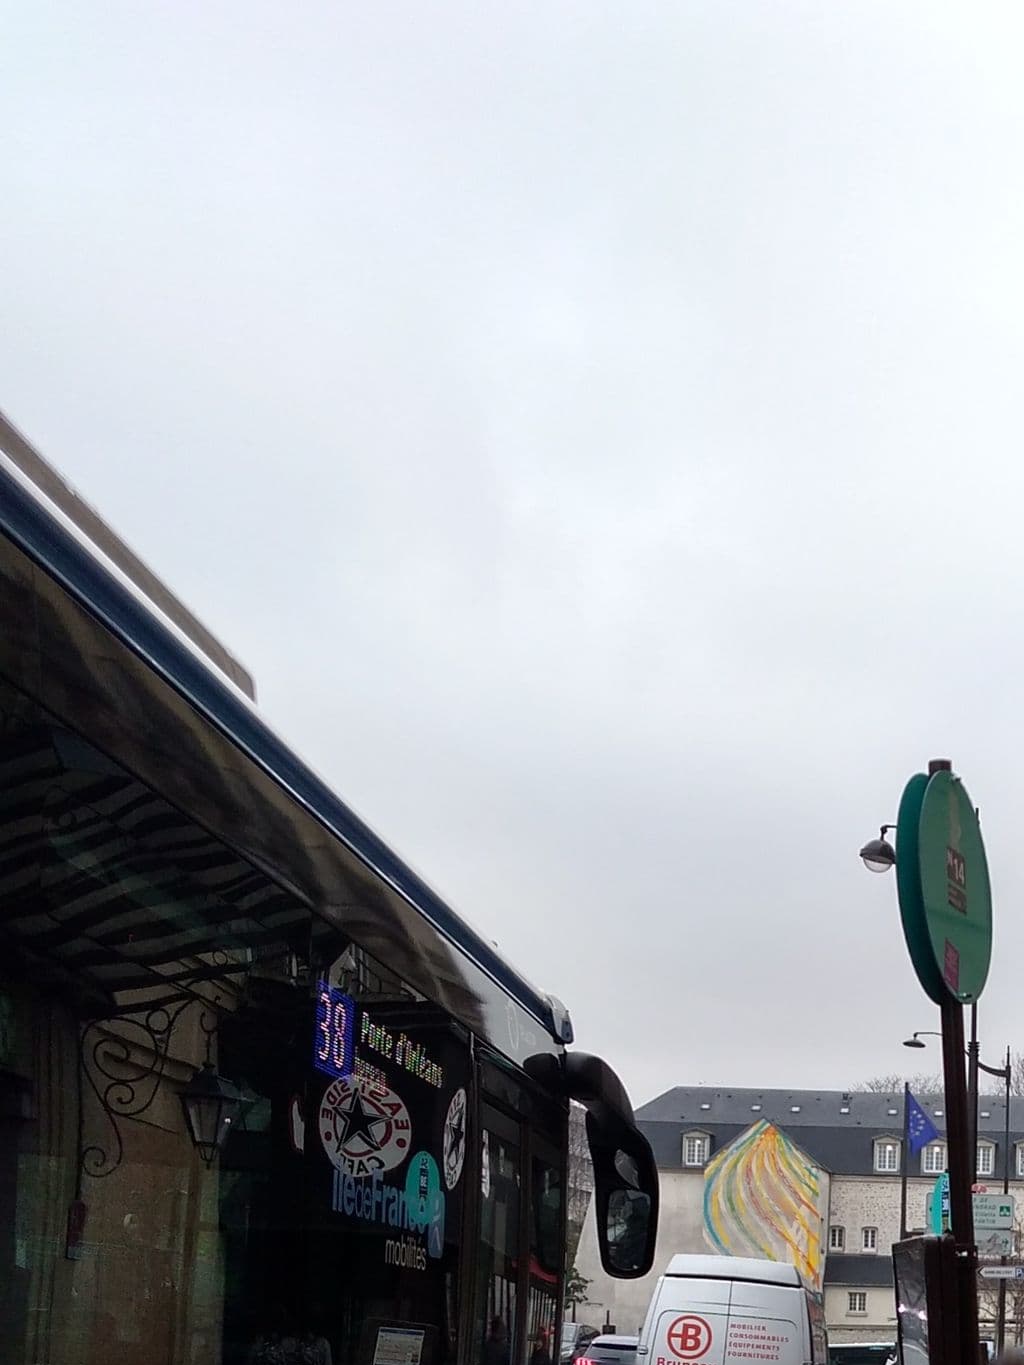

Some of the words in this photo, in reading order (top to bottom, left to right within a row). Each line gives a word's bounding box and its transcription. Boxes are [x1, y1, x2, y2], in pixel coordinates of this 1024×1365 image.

[317, 991, 346, 1069] 38
[384, 1234, 428, 1272] mobilités
[729, 1323, 767, 1332] MOBILIER
[729, 1332, 789, 1343] CONSOMMABLES
[727, 1351, 780, 1360] FOURNITURES
